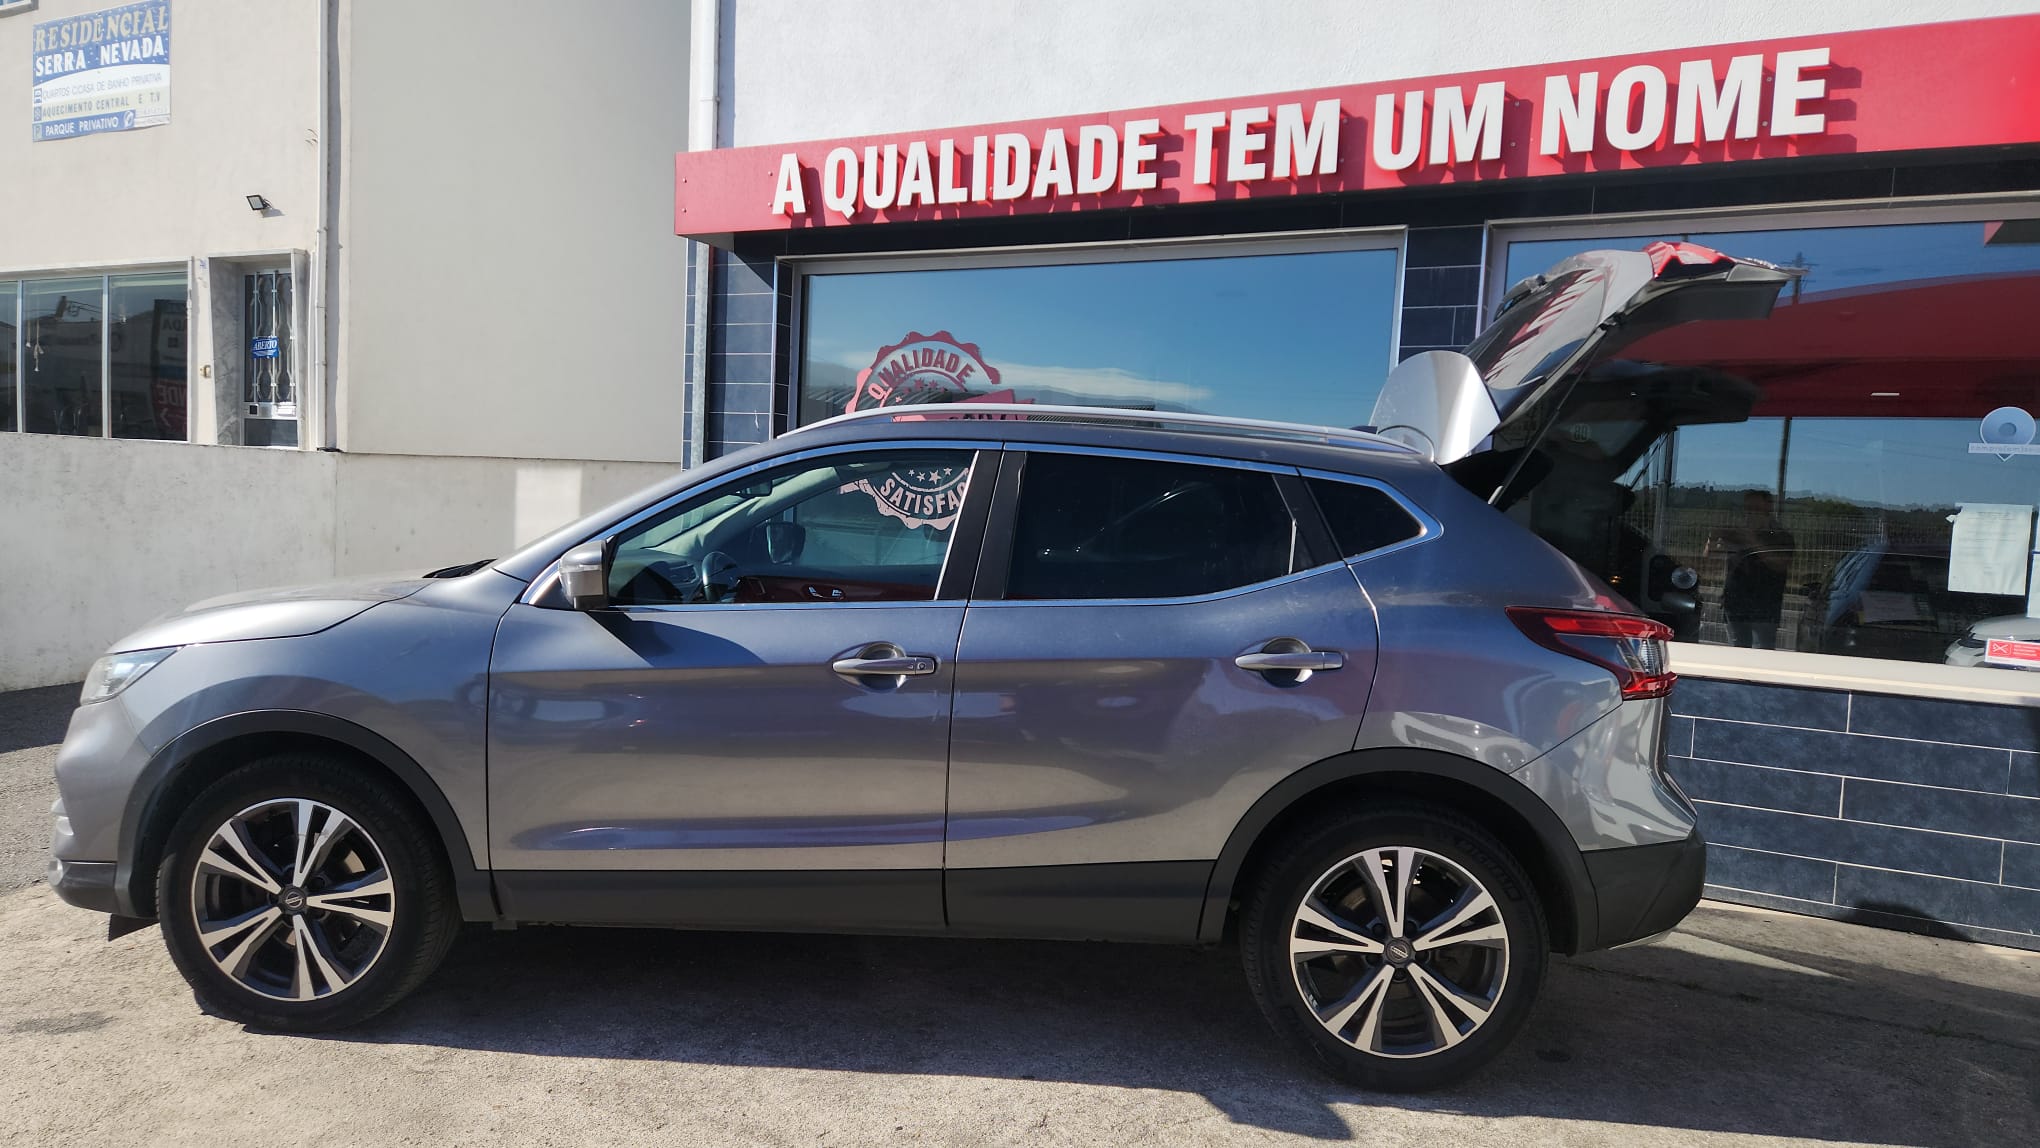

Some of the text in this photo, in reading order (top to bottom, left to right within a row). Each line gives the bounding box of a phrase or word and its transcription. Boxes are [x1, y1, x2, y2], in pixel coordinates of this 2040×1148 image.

[35, 6, 169, 51] RESIDENCIAL
[36, 35, 165, 77] SERRA NEVADA
[43, 101, 93, 117] AQUECIMENTO
[96, 96, 130, 110] CENTRAL
[45, 121, 75, 136] PARQUE
[79, 117, 119, 131] PRIVATIVO
[772, 47, 1831, 219] A QUALIDADE TEM UM NOME
[254, 340, 278, 350] ABERTO
[867, 348, 976, 400] QUALIDADE
